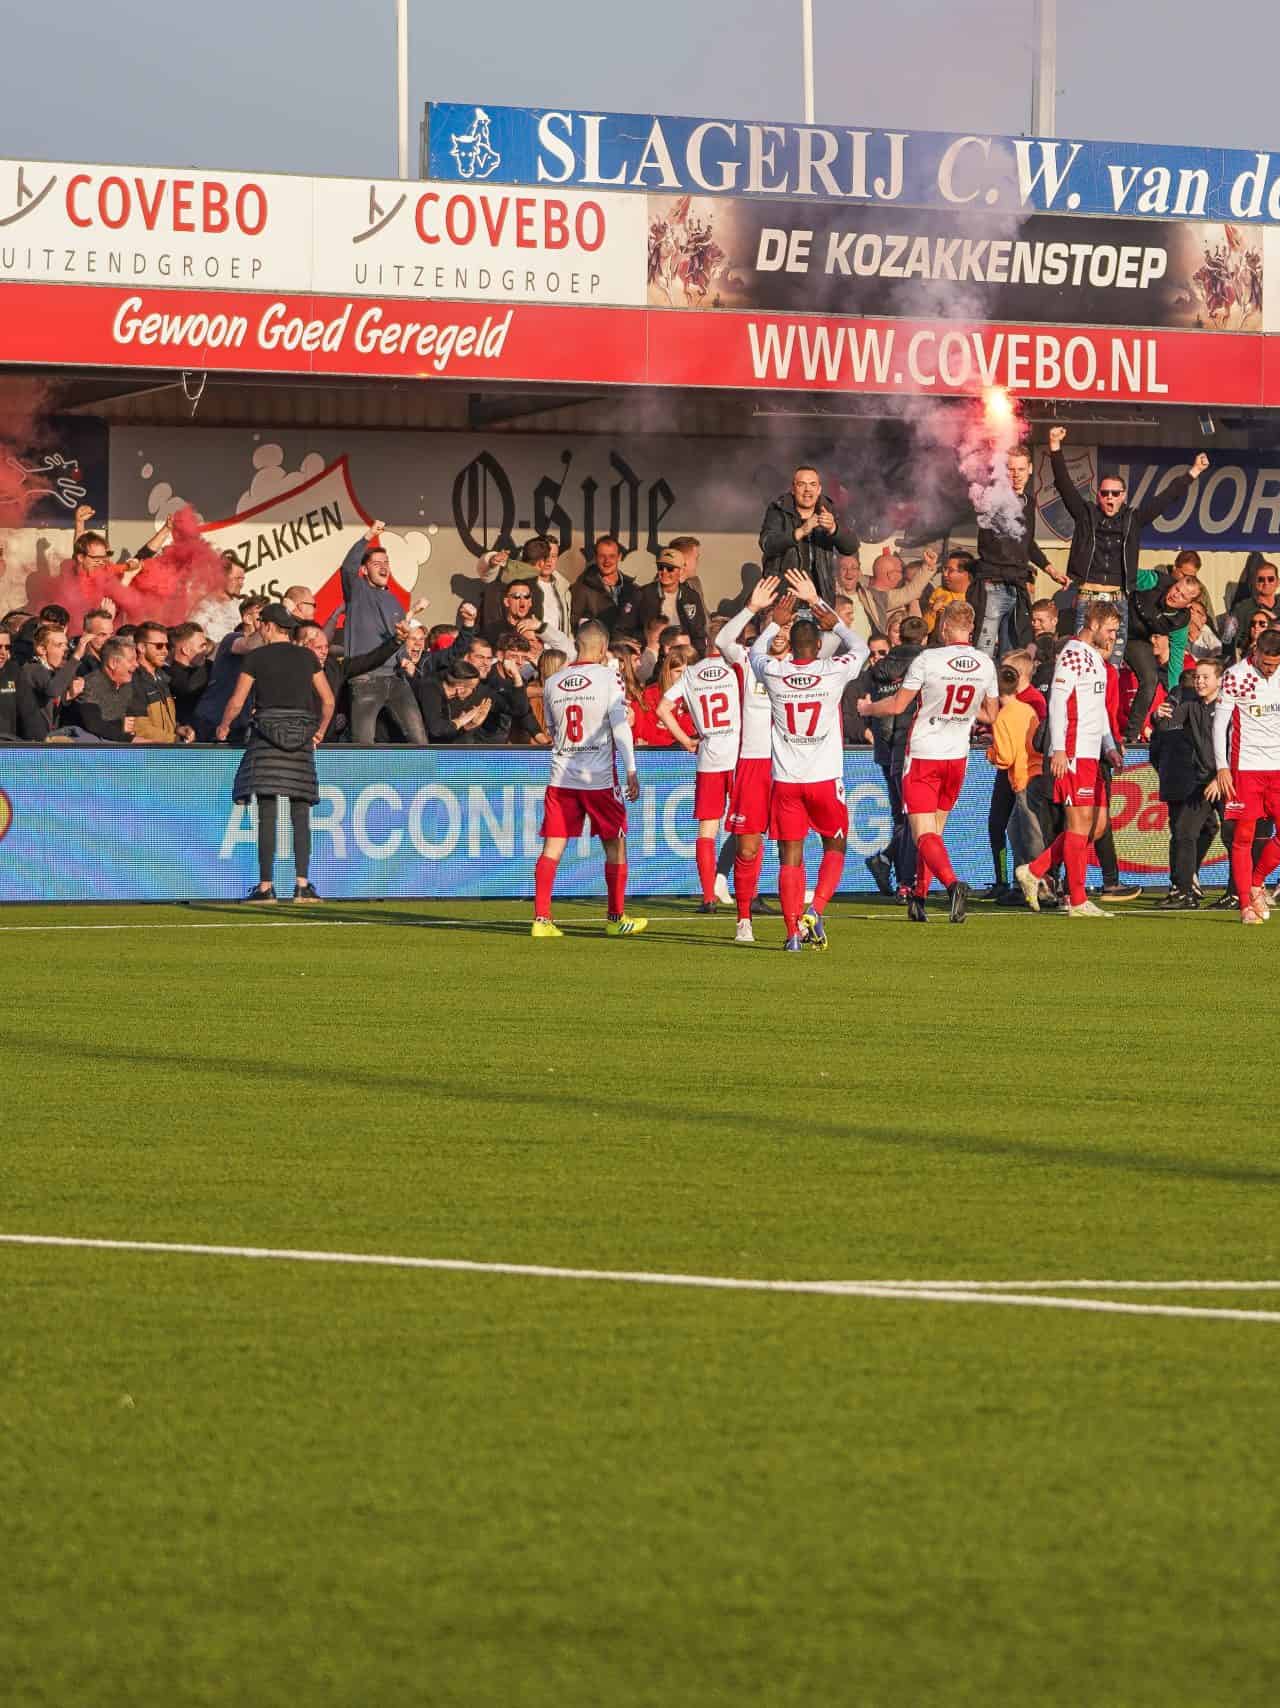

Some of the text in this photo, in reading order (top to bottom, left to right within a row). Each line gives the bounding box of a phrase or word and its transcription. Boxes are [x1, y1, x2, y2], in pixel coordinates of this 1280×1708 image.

[537, 111, 908, 200] SLAGERIJ
[937, 134, 1082, 209] C.W.
[1107, 164, 1208, 217] van
[65, 173, 268, 236] COVEBO
[415, 192, 606, 252] COVEBO
[2, 246, 264, 280] UITZENDGROEP
[756, 229, 1168, 290] DE KOZAKKENSTOEP
[354, 262, 602, 295] UITZENDGROEP
[113, 296, 514, 371] Gewoon Goed Geregeld
[748, 322, 1169, 394] WWW.COVEBO.NL
[563, 677, 584, 688] NELF
[703, 669, 722, 679] NELF
[790, 676, 813, 686] NELF
[955, 659, 975, 669] NELF
[699, 691, 732, 729] 12
[942, 684, 976, 715] 19
[565, 704, 584, 744] 8
[784, 701, 823, 737] 17
